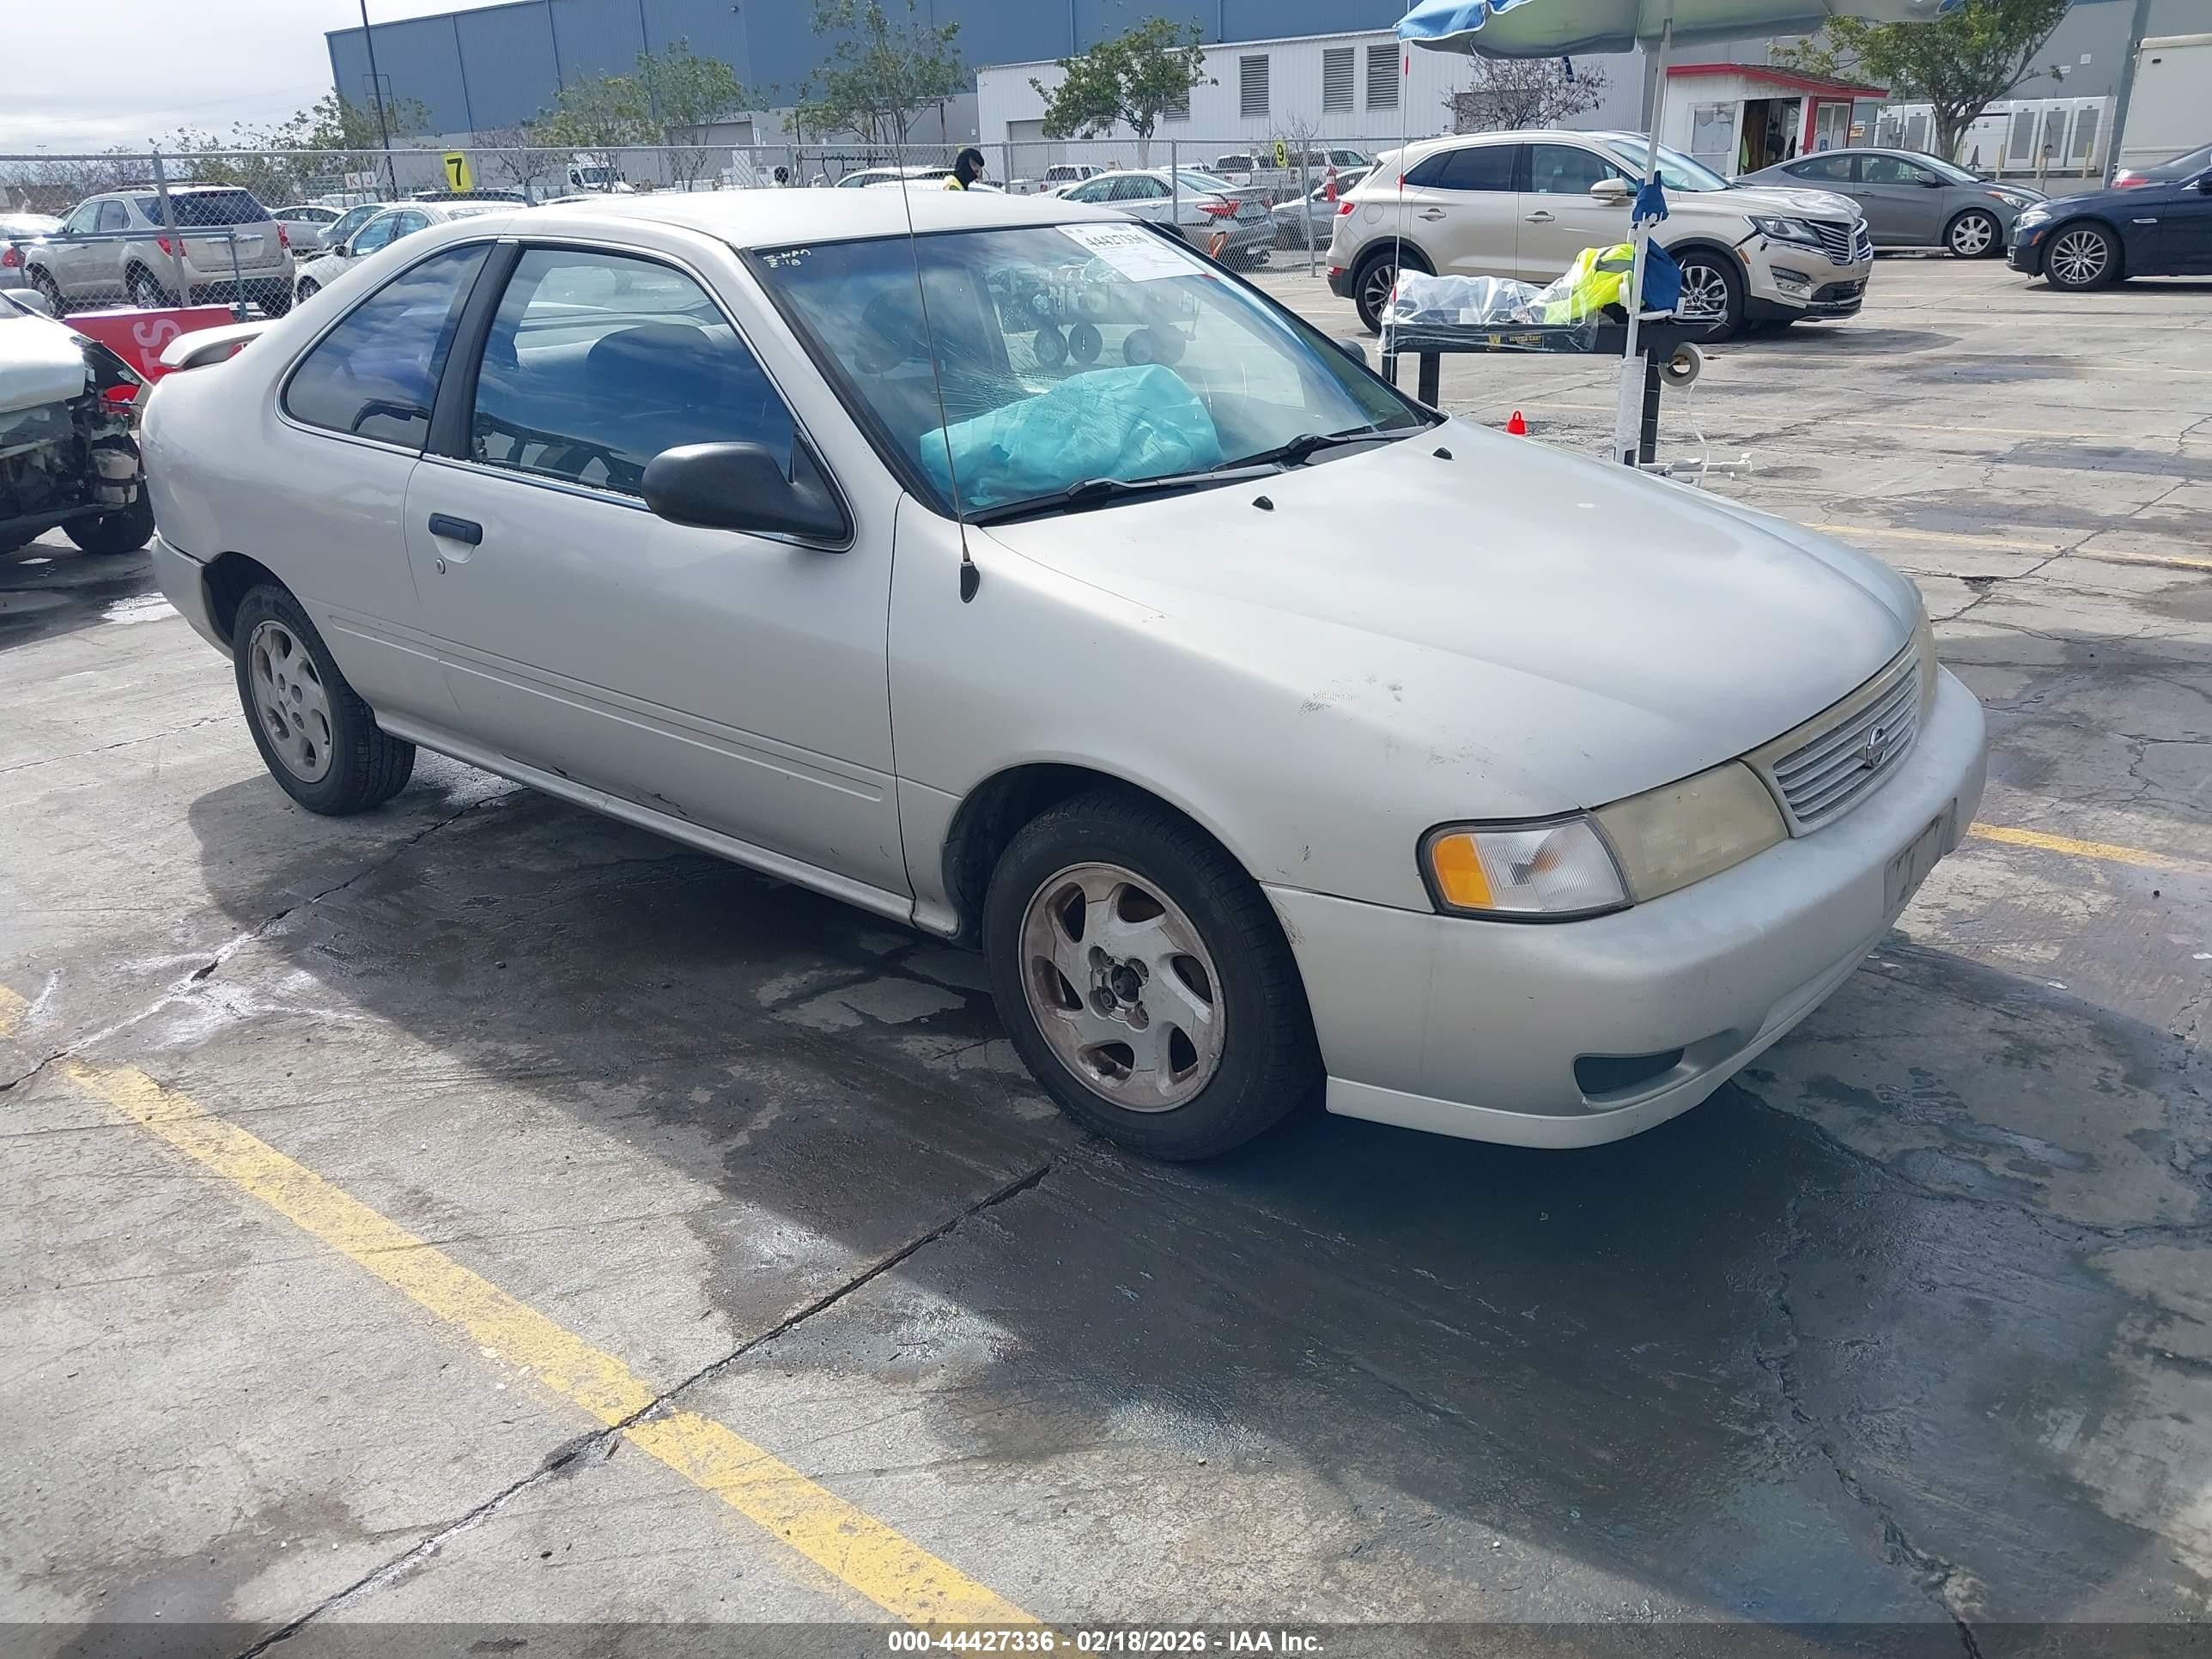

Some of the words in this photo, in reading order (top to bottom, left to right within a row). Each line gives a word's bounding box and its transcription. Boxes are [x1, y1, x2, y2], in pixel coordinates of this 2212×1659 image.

[1277, 143, 1285, 162] 9
[447, 157, 463, 186] 7
[349, 174, 358, 186] K
[367, 174, 373, 185] J
[1085, 234, 1149, 247] 44427336
